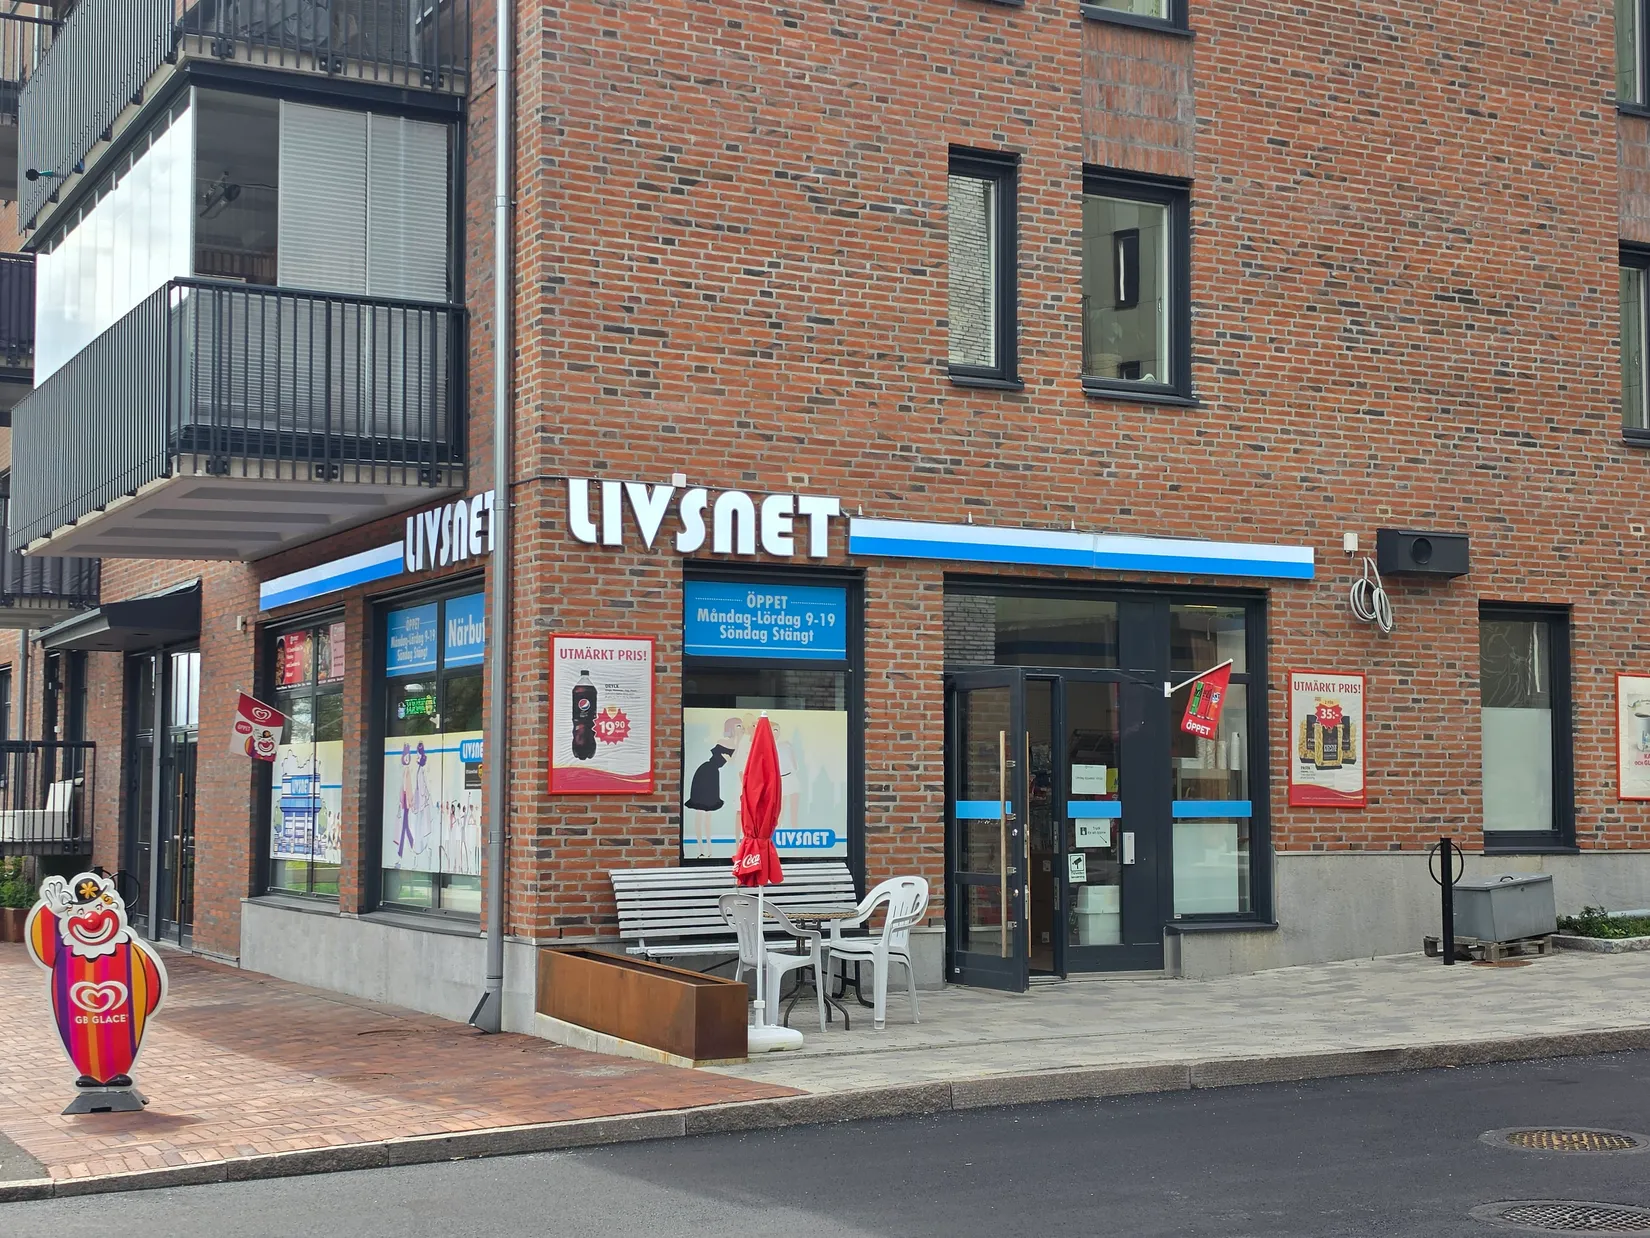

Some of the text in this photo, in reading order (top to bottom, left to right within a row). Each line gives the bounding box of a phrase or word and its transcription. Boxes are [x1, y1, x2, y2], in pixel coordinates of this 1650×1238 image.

[569, 478, 840, 558] LIVSNET
[746, 590, 788, 609] ÖPPET
[697, 608, 836, 628] Måndag-Lördag 9-19
[720, 625, 814, 643] Söndag Stängt
[560, 646, 647, 661] UTMÄRKT PRIS!
[1294, 680, 1361, 693] UTMÄRKT PRIS!
[1320, 708, 1339, 720] 35:-
[1186, 719, 1210, 735] ÖPPET
[775, 832, 829, 845] LIVSNET
[743, 854, 760, 868] Coca
[75, 1014, 126, 1024] GB GLACE
